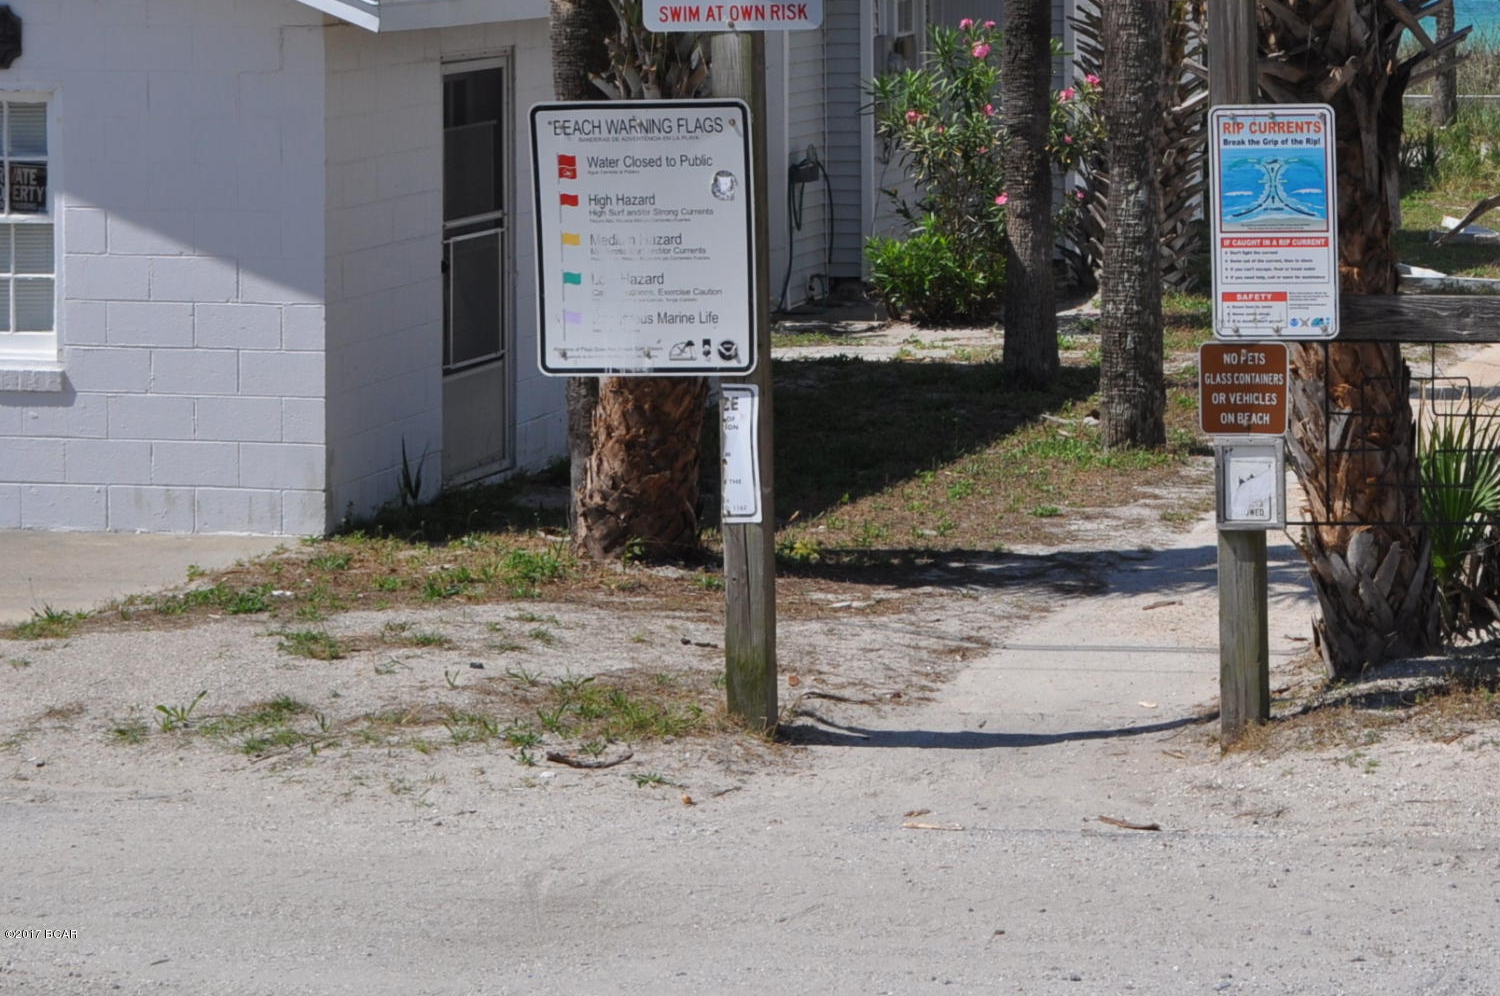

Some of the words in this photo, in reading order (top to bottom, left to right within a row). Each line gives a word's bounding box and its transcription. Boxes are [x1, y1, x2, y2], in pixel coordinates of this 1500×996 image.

[659, 5, 700, 23] SWIM
[705, 5, 725, 22] AT
[729, 4, 765, 21] OWN
[770, 3, 808, 21] RISK
[553, 119, 601, 136] BEACH
[606, 117, 673, 135] WARNING
[677, 116, 724, 134] FLAGS
[1223, 121, 1245, 134] RIP
[1249, 120, 1322, 134] CURRENTS
[1223, 138, 1246, 146] Break
[1262, 138, 1279, 147] Grip
[1305, 137, 1320, 147] Rip!
[586, 155, 619, 169] Water
[622, 155, 663, 168] Closed
[666, 156, 677, 167] to
[680, 154, 713, 167] Public
[588, 194, 613, 209] High
[616, 193, 656, 206] Hazard
[1291, 238, 1325, 246] CURRENT
[1236, 293, 1273, 301] SAFETY
[657, 311, 695, 324] Marine
[699, 311, 719, 324] Life
[1223, 352, 1238, 364] NO
[1240, 352, 1266, 365] PETS
[1204, 373, 1232, 385] GLASS
[1233, 373, 1284, 385] CONTAINERS
[1211, 392, 1226, 404] OR
[1229, 392, 1278, 405] VEHICLES
[1220, 412, 1235, 424] ON
[1237, 412, 1270, 424] BEACH
